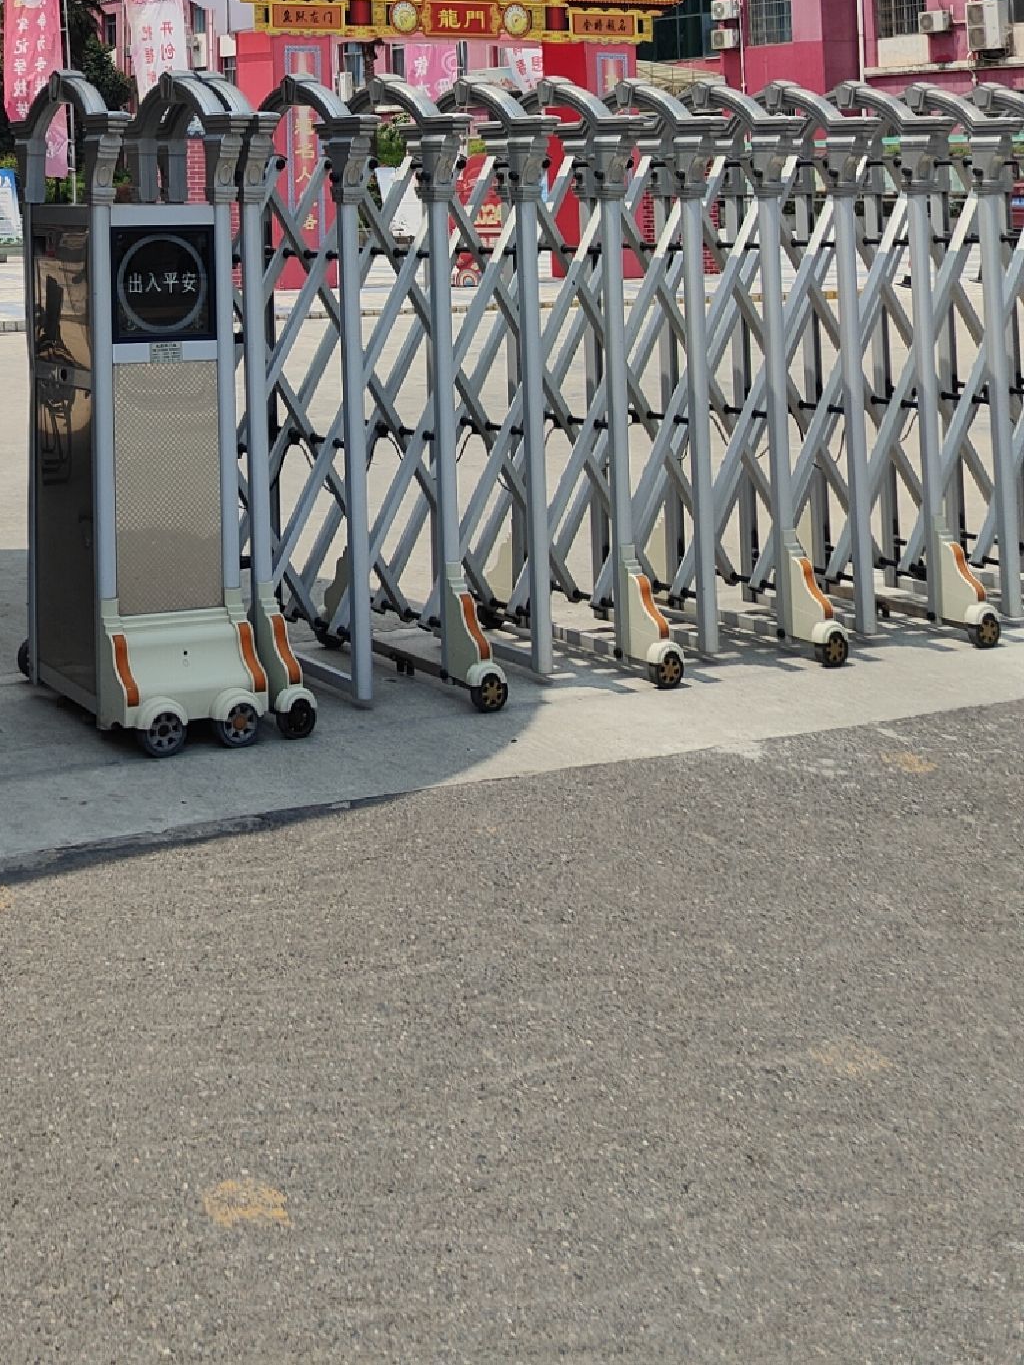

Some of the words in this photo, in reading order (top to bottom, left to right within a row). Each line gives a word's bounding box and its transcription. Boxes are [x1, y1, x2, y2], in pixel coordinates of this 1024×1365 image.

[438, 8, 486, 30] 龍門
[128, 271, 198, 294] 出入平安
